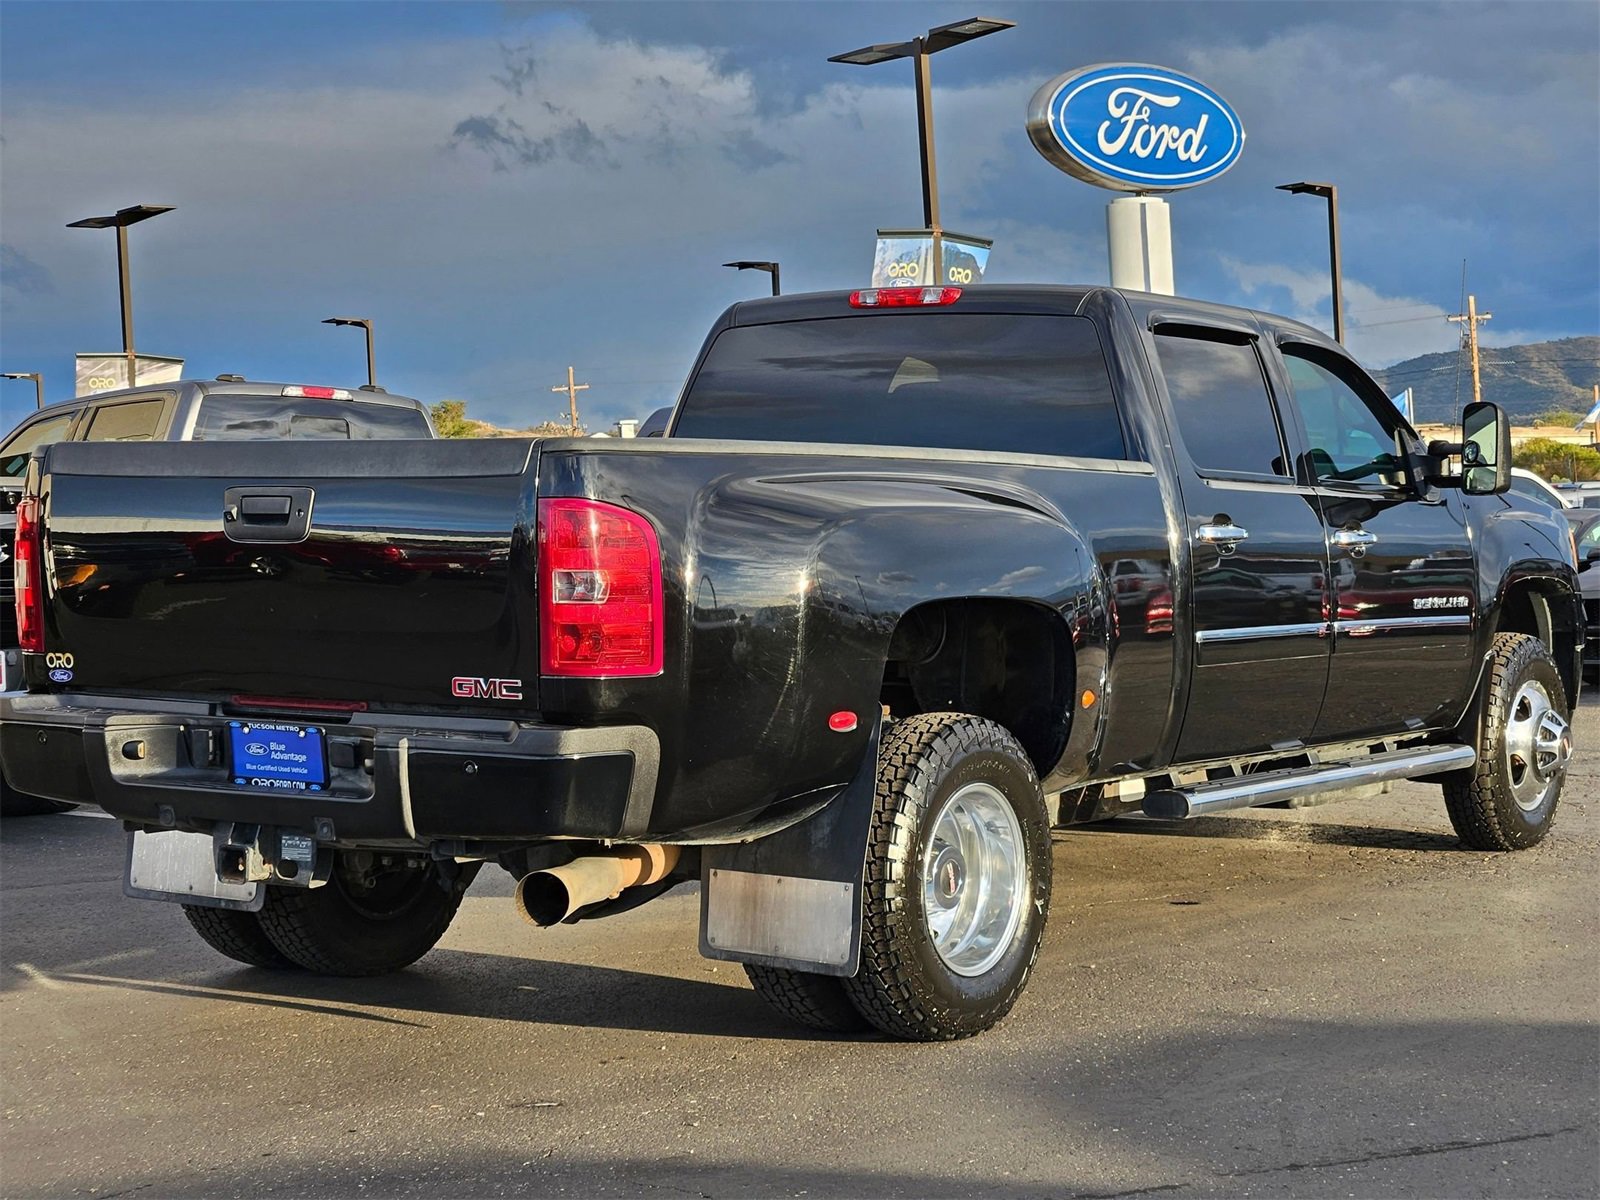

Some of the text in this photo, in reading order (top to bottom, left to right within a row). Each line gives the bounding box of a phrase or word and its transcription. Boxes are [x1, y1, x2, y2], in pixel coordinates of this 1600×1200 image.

[1097, 87, 1209, 163] Ford
[888, 262, 919, 277] ORO
[949, 266, 972, 284] ORO
[88, 378, 116, 389] ORO
[46, 652, 74, 668] ORO
[53, 670, 70, 680] Ford
[452, 676, 523, 700] GMC
[249, 744, 265, 754] Ford
[270, 742, 286, 751] Blue
[271, 751, 307, 762] Advantage
